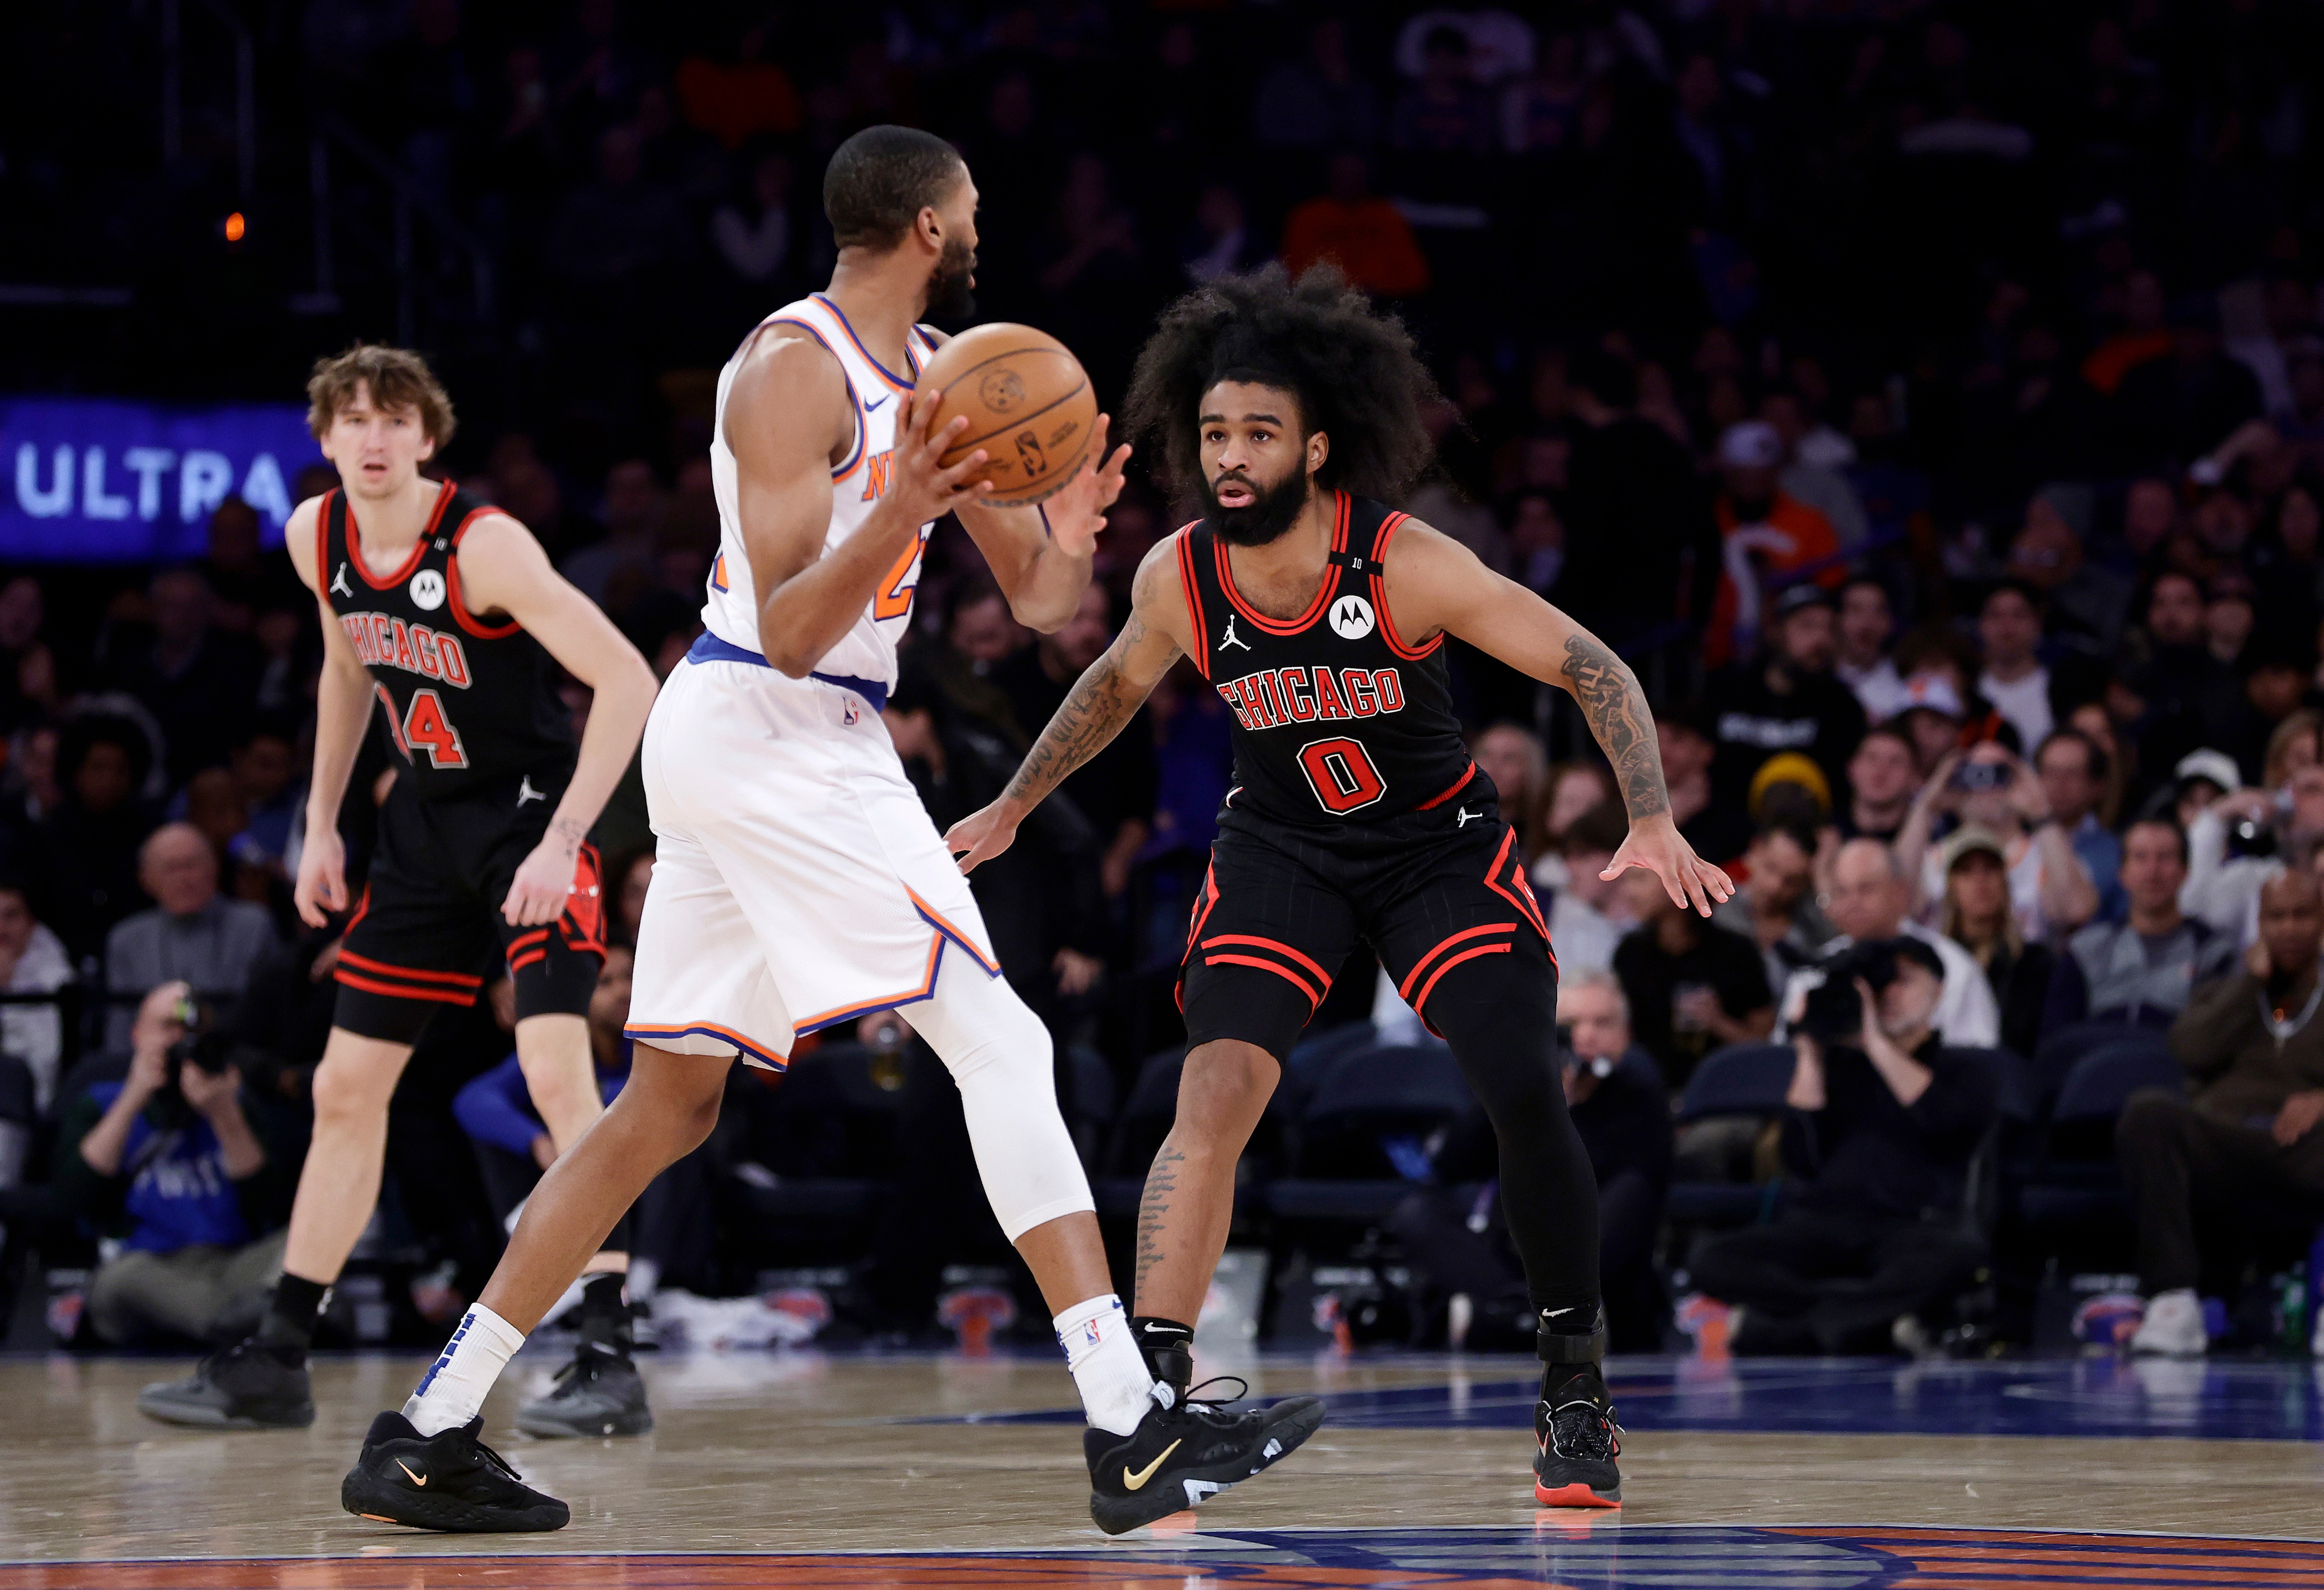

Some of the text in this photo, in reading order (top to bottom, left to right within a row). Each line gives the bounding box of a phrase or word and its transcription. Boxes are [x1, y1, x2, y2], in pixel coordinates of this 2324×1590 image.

[16, 441, 295, 528] ULTRA
[434, 537, 449, 552] 10
[1352, 557, 1362, 570] 10
[338, 611, 473, 689] HICAGO
[1216, 666, 1406, 730] CHICAGO
[1296, 736, 1387, 816] 0
